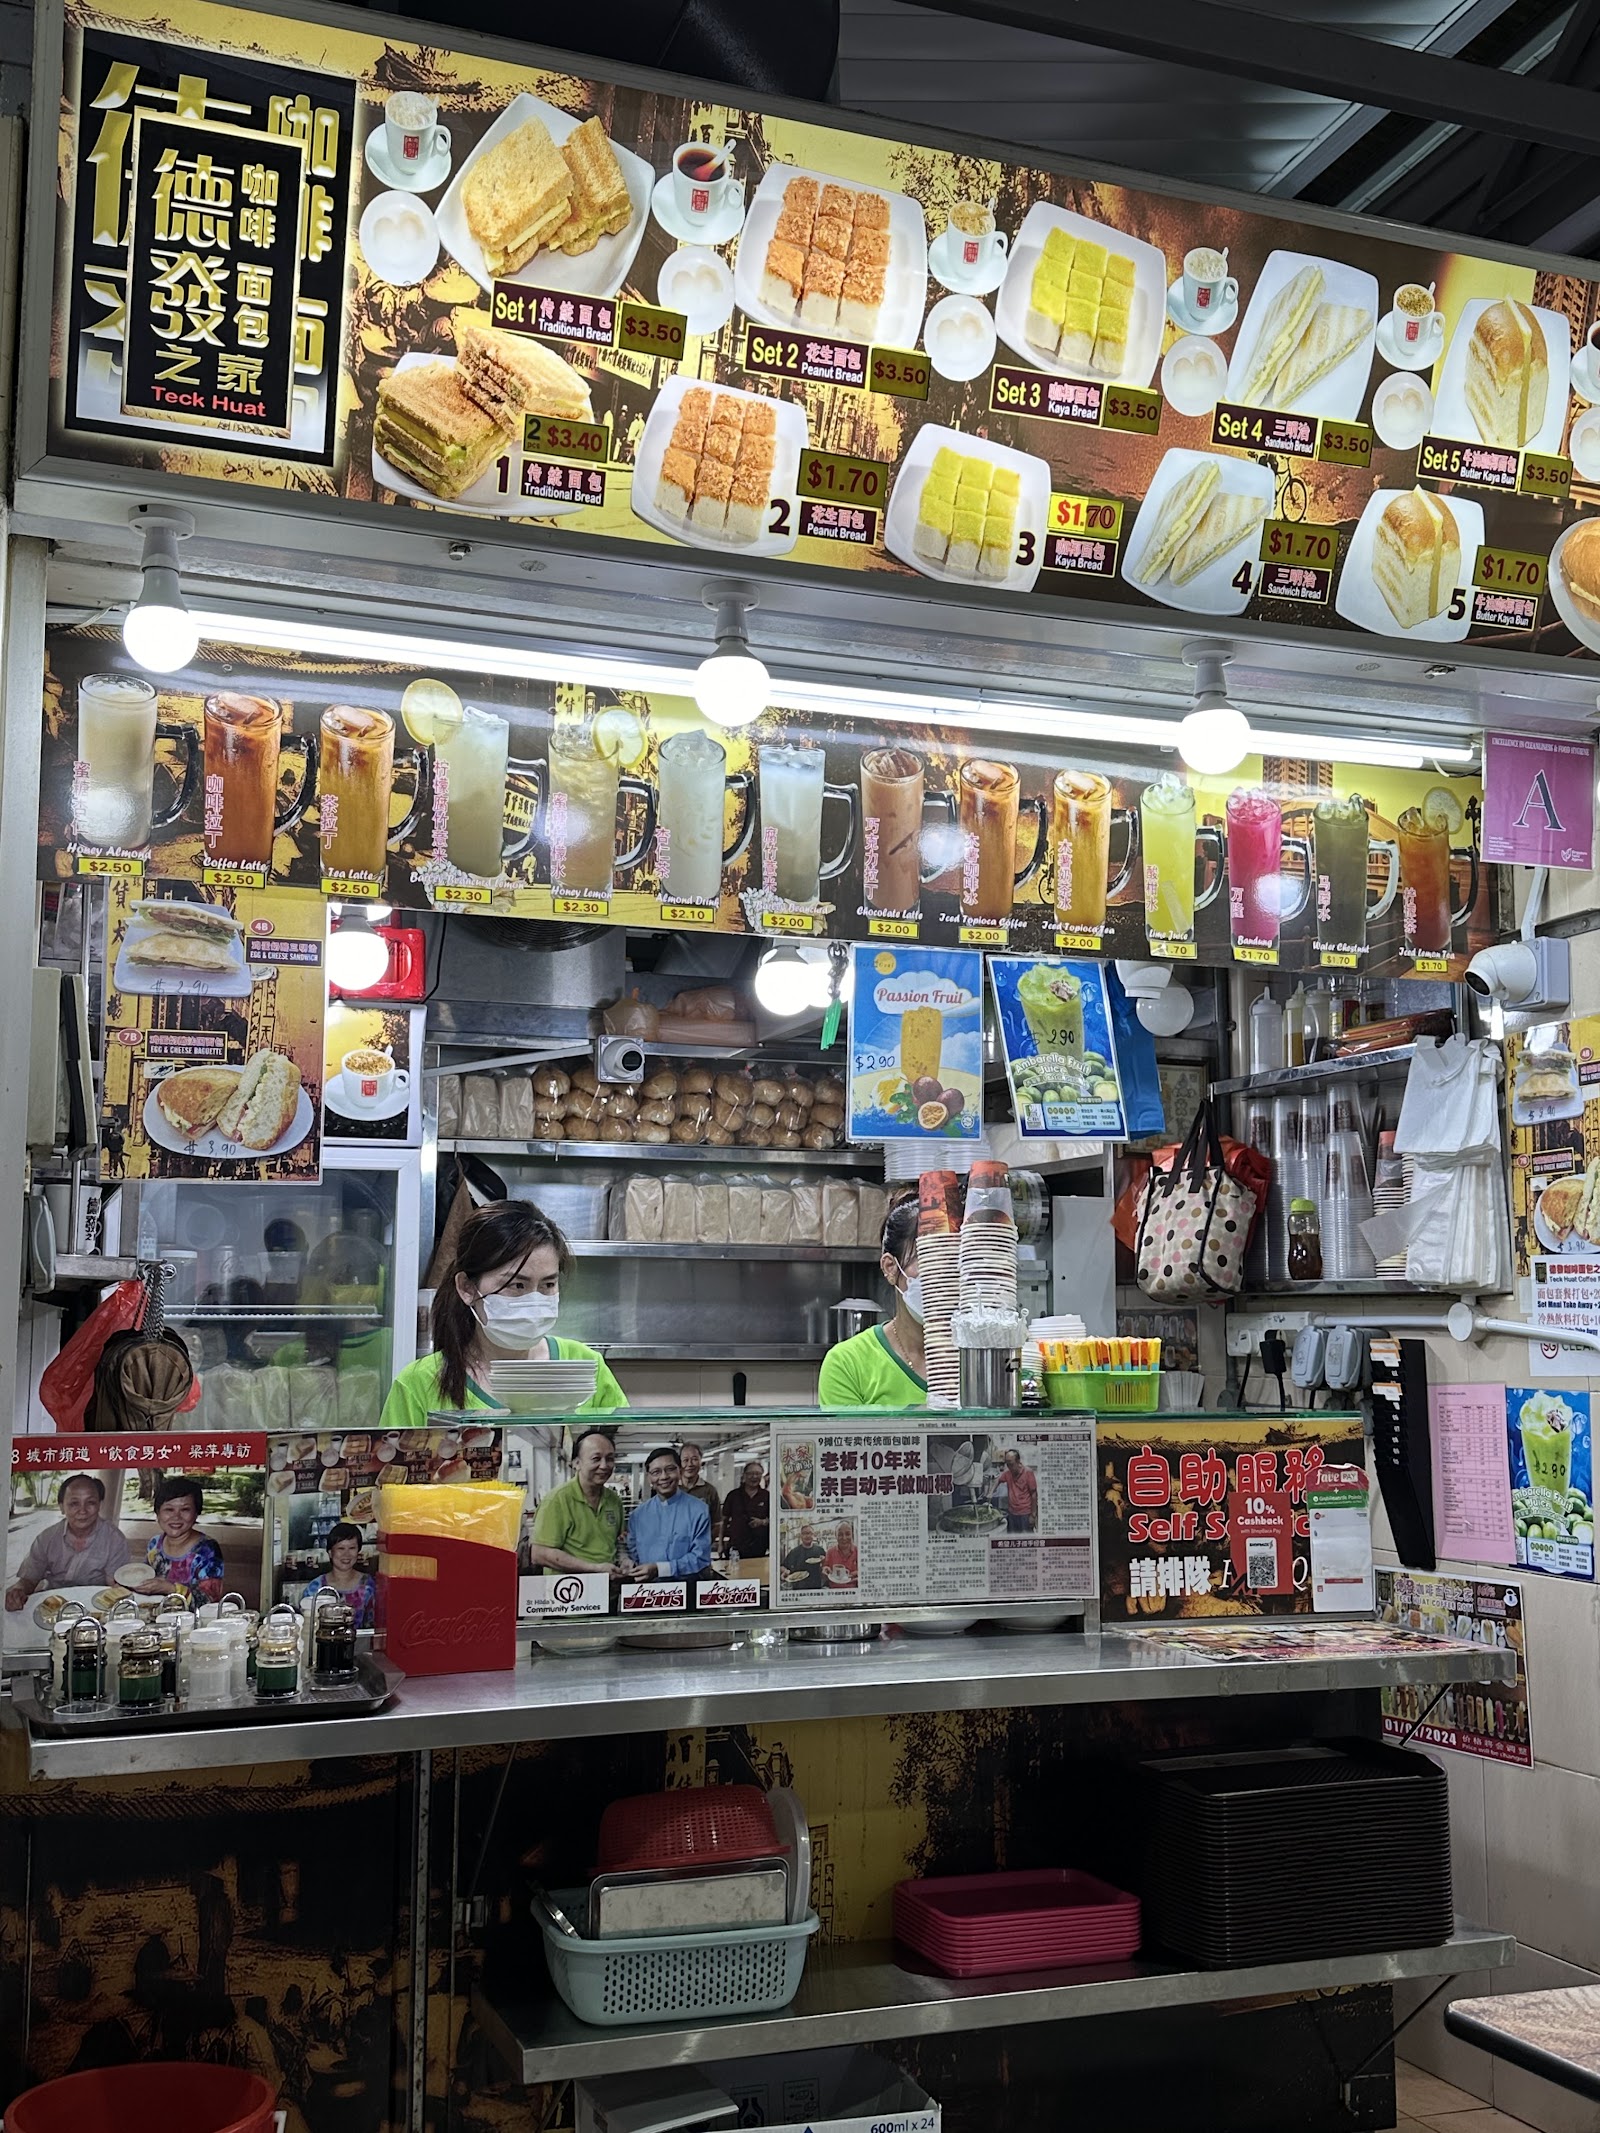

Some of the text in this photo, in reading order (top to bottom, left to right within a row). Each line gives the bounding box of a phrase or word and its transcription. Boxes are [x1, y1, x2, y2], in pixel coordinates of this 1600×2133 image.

[495, 292, 537, 325] Set 1
[538, 318, 612, 343] Traditional Bread
[624, 316, 682, 344] $3.50
[752, 337, 798, 368] Set 2
[154, 343, 262, 395] 之家
[801, 362, 863, 384] Peanut Bread
[874, 360, 926, 385] $3.50
[151, 386, 266, 417] Teck Huat
[996, 377, 1041, 408] Set 3
[1048, 402, 1097, 420] Kaya Bread
[1108, 398, 1158, 421] $3.50
[527, 418, 602, 452] 2 $3.40
[1218, 413, 1263, 442] Set 4
[1264, 435, 1313, 454] Sandwich Bread
[1323, 432, 1369, 453] $3.50
[1423, 446, 1461, 473] Set 5
[496, 455, 510, 493] 1
[807, 459, 878, 496] $1.70
[1483, 470, 1515, 486] Kaya Bun
[1526, 464, 1568, 485] $3.50
[524, 483, 602, 505] Traditional Bread
[768, 498, 790, 536] 2
[1057, 499, 1116, 529] $1.70
[807, 523, 867, 542] Peanut Bread
[1015, 531, 1036, 566] 3
[1269, 528, 1330, 560] $1.70
[1055, 554, 1103, 571] Kaya Bread
[1482, 554, 1539, 585] $1.70
[1232, 560, 1253, 595] 4
[1267, 583, 1322, 600] Sandwich Bread
[1447, 588, 1466, 620] 5
[1475, 610, 1529, 626] Butter Kaya Bun
[1512, 769, 1566, 832] A
[205, 773, 224, 849] 咖啡拉丁
[320, 794, 339, 850] 茶拉丁
[67, 842, 151, 860] Honey Almond
[654, 827, 671, 880] 杏仁茶
[864, 816, 881, 899] 巧克力拉丁
[89, 860, 132, 873] $2.50
[203, 855, 269, 872] Coffee Latte
[963, 832, 980, 907] 木薯咖啡冰
[213, 872, 255, 886] $2.50
[328, 867, 374, 881] Tea Latte
[1057, 839, 1073, 911] 木薯奶茶冰
[330, 881, 370, 895] $2.50
[445, 889, 482, 901] $2.30
[551, 885, 613, 900] Honey Lemon
[1145, 864, 1160, 912] 酸柑水
[563, 901, 599, 913] $2.30
[656, 892, 720, 908] Almond Drink
[1230, 886, 1245, 919] 万隆
[670, 908, 705, 920] $2.10
[771, 915, 804, 928] $2.00
[856, 906, 924, 922] Chocolate Latte
[938, 912, 1028, 930] Iced Coffee
[255, 922, 268, 931] 4B
[877, 923, 910, 936] $2.00
[968, 929, 1000, 942] $2.00
[1041, 920, 1115, 936] Iced Tea
[1062, 936, 1094, 949] $2.00
[1169, 931, 1188, 941] Juice
[1237, 934, 1272, 948] Bandung
[250, 951, 318, 962] EGG CHEESE SANDWICH
[1240, 949, 1270, 961] $1.70
[1326, 955, 1350, 966] $1.70
[1416, 948, 1456, 960] Lemon Tea
[1421, 961, 1442, 971] $1.70
[176, 980, 209, 995] 2.90
[877, 988, 963, 1004] Passion Fruit
[123, 1033, 137, 1041] 7B
[150, 1046, 222, 1056] EGG CHEESE BAGUETTE
[1014, 1052, 1092, 1076] Ambarella Fruit
[1039, 1065, 1068, 1075] Juice
[208, 1143, 237, 1156] 3.90
[26, 1445, 91, 1463] 城市頻道
[820, 1451, 921, 1472] 老板10年来
[820, 1474, 953, 1497] 亲自动手做咖椰
[1315, 1469, 1340, 1485] fave
[1245, 1497, 1275, 1515] 10%
[1129, 1511, 1198, 1543] Self
[1237, 1516, 1284, 1526] Cashback
[1129, 1555, 1212, 1598] 請排隊
[642, 1595, 681, 1607] PLUS
[714, 1592, 756, 1605] SPECIAL
[526, 1604, 601, 1614] Community Services
[1491, 1748, 1499, 1756] be
[1500, 1750, 1528, 1763] changed
[871, 2118, 935, 2133] 600ml 24
